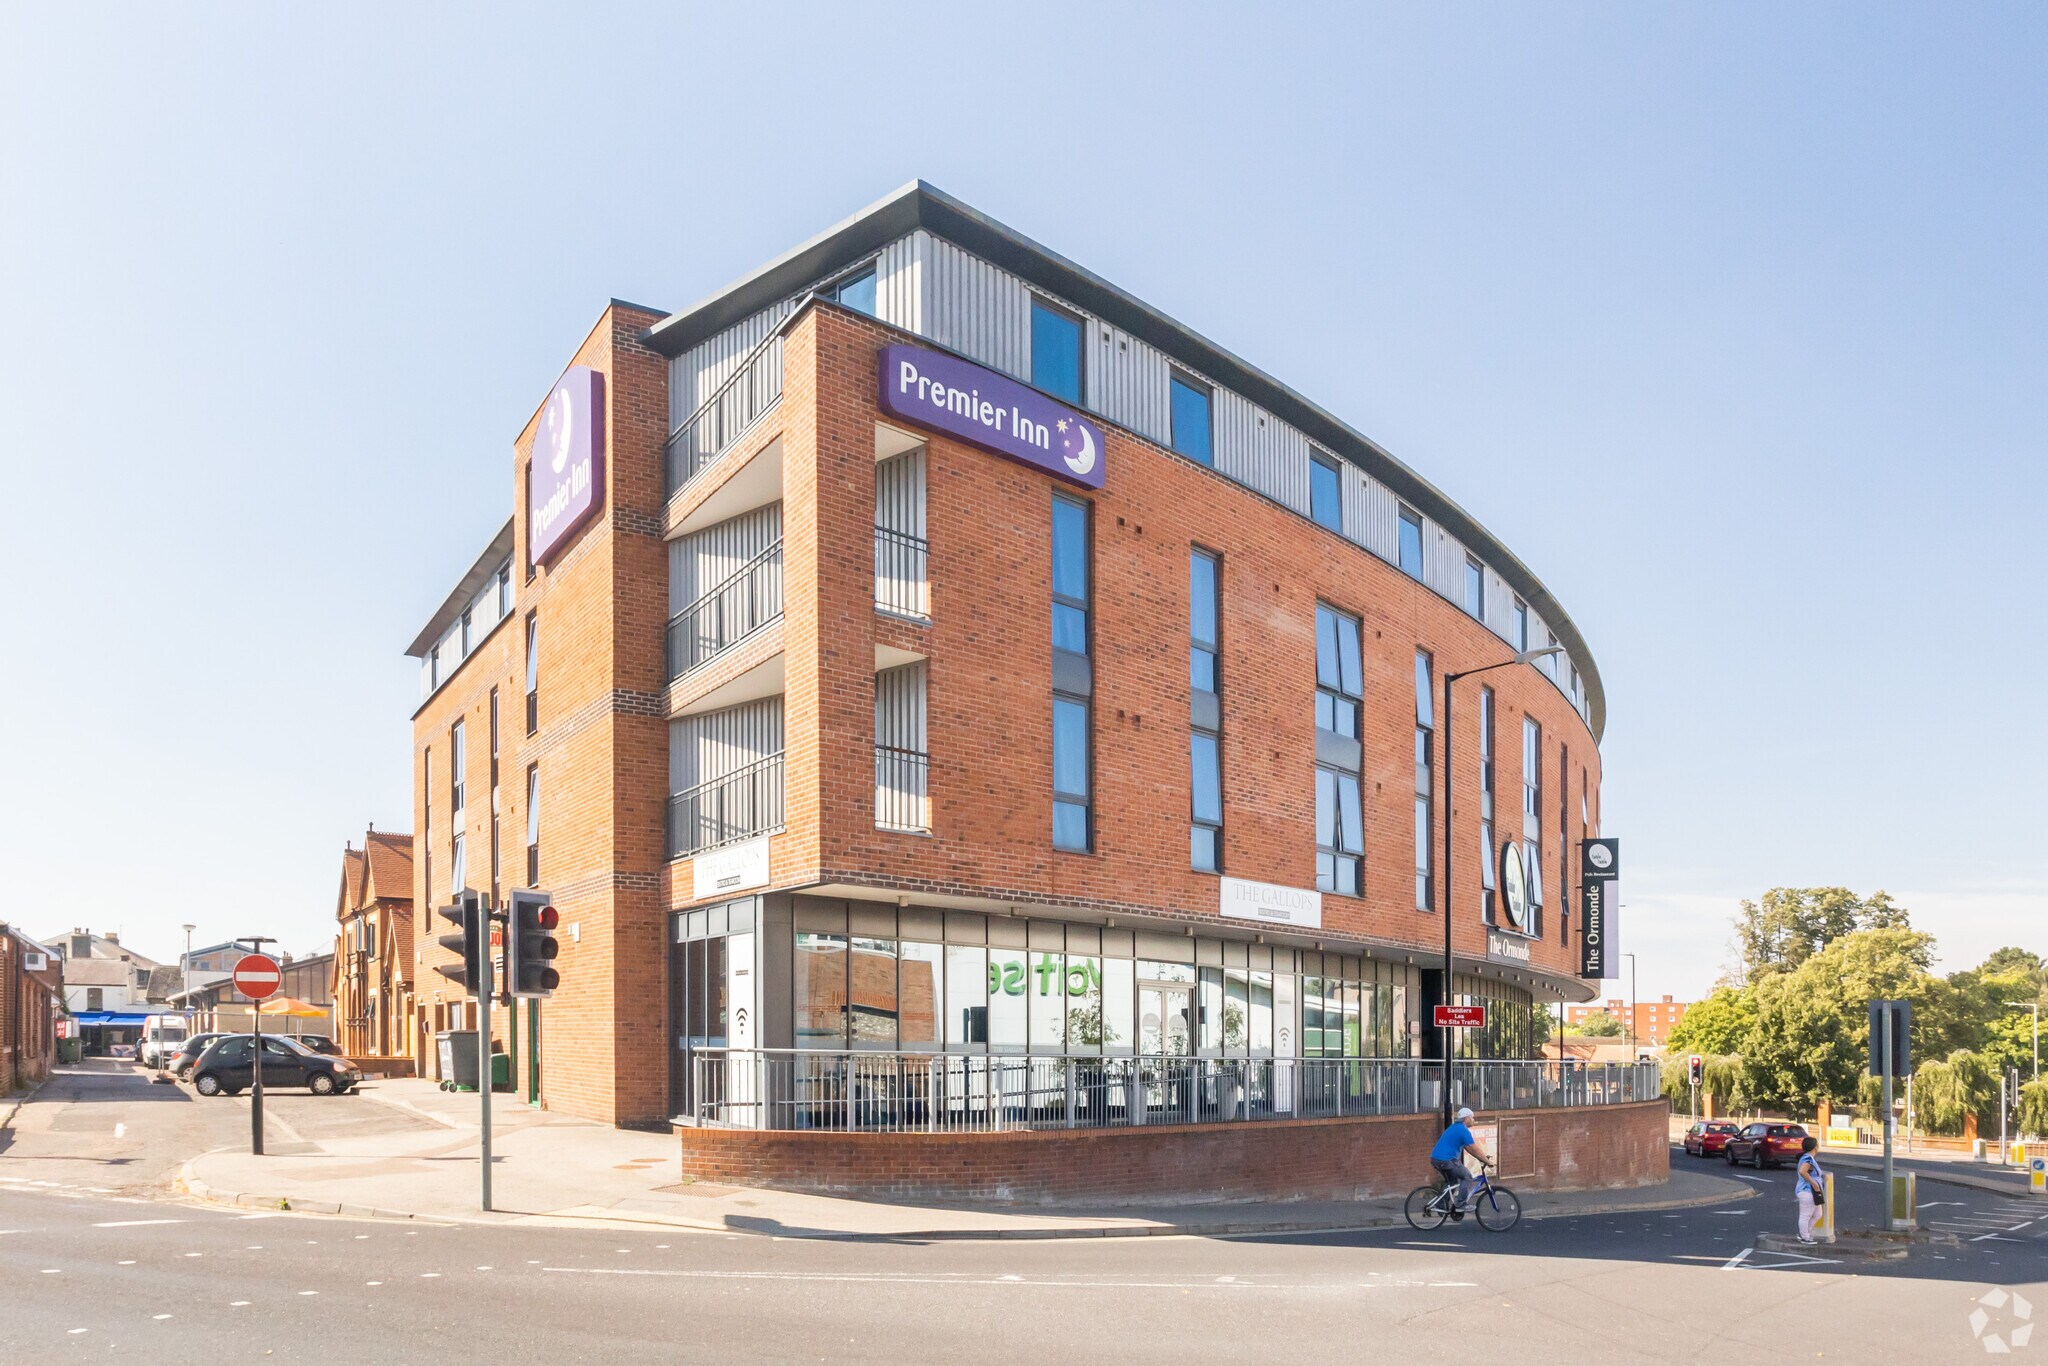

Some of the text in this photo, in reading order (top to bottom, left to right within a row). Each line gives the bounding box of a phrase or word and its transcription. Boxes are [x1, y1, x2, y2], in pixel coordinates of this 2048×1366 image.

[900, 361, 1050, 450] Premier Inn
[533, 457, 589, 543] Premier Inn
[1233, 883, 1313, 911] THE GALLOPS
[1586, 885, 1599, 972] The Ormonde
[1489, 935, 1530, 961] The Ormonde
